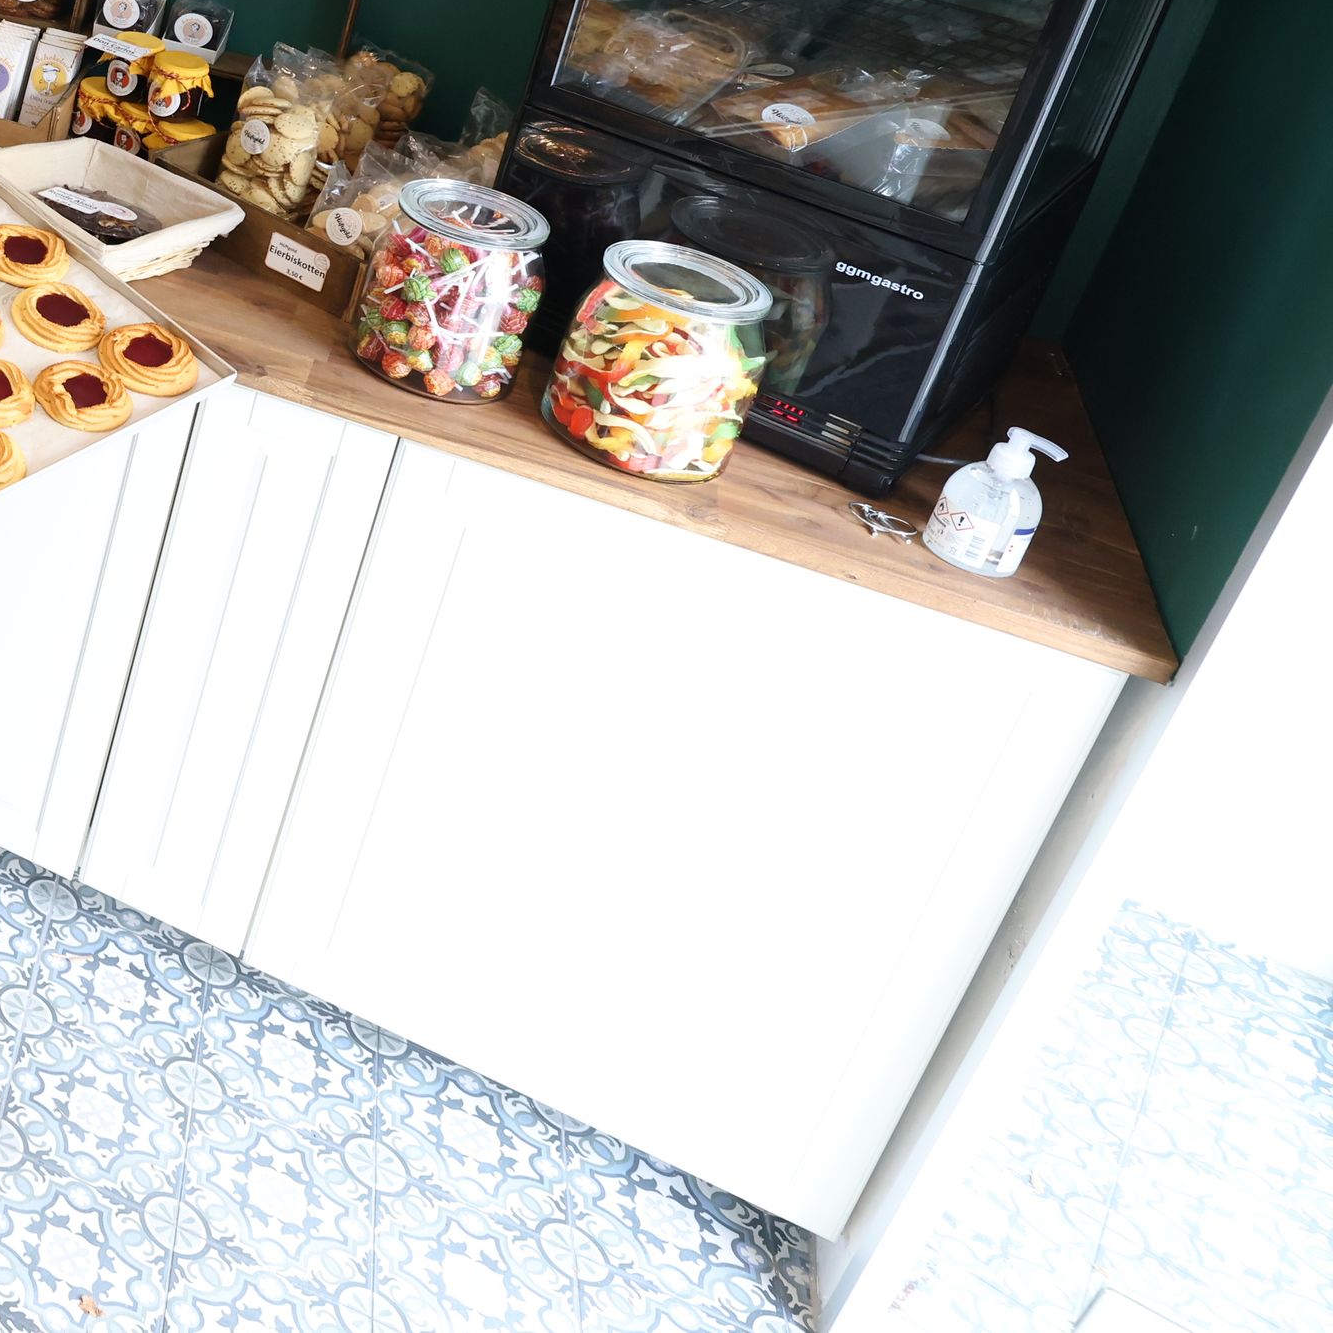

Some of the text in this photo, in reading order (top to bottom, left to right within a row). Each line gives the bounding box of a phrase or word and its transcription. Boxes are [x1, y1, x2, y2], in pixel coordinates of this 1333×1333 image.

[269, 245, 325, 279] Eierbiskotten
[286, 268, 299, 278] 3,50
[835, 261, 924, 300] ggmgastro
